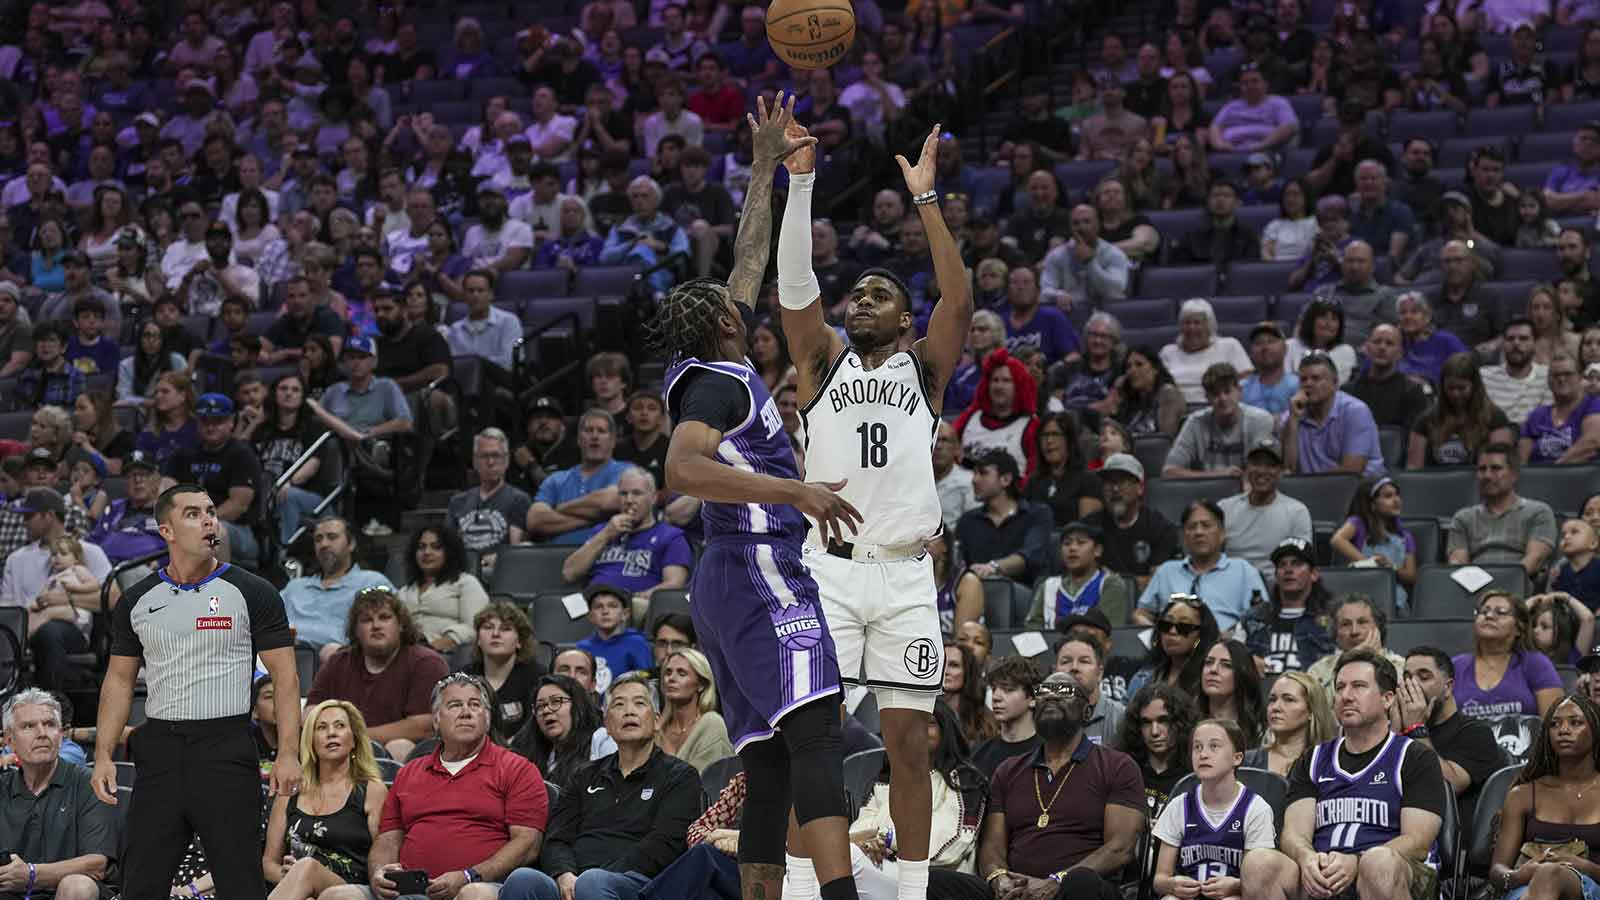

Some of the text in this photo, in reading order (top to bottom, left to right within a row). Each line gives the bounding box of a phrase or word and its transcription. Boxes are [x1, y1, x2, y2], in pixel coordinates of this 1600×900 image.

[829, 378, 921, 417] BROOKLYN
[856, 422, 888, 468] 18
[197, 618, 232, 628] Emirates
[774, 618, 821, 638] KINGS
[917, 644, 930, 673] B
[1316, 797, 1389, 829] ACRAMENTO
[1330, 822, 1361, 848] 11
